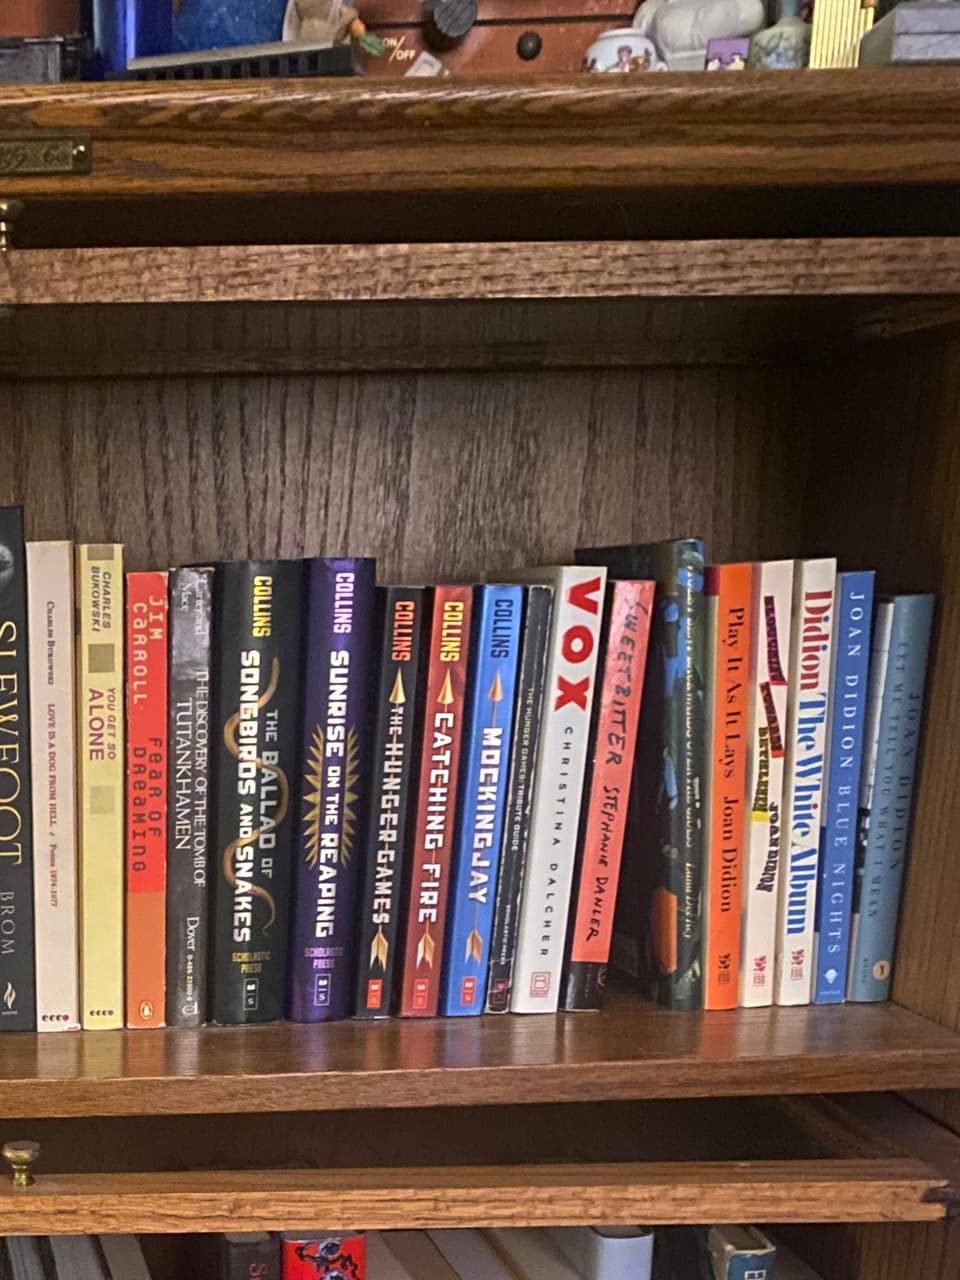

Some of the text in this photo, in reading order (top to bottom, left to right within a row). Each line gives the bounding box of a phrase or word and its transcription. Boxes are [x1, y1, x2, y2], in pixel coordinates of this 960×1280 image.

[91, 566, 101, 632] BUKOWSKI
[100, 572, 112, 629] CHARLES
[252, 576, 273, 637] COLLINS
[88, 688, 105, 761] ALONE
[175, 697, 192, 850] TUTANKHAMEN
[316, 573, 354, 938] COLLINS SUNRISE ON THE REAPING
[418, 602, 463, 924] COLLINS CATCHING FIRE
[469, 599, 513, 903] COLLINS MOCKINGJAY
[540, 576, 600, 955] VOX CHRISTINA DALCHER
[826, 592, 866, 955] JOAN DIDION BLUE NIGHTS
[0, 891, 16, 955] BROM
[186, 917, 199, 951] Dover
